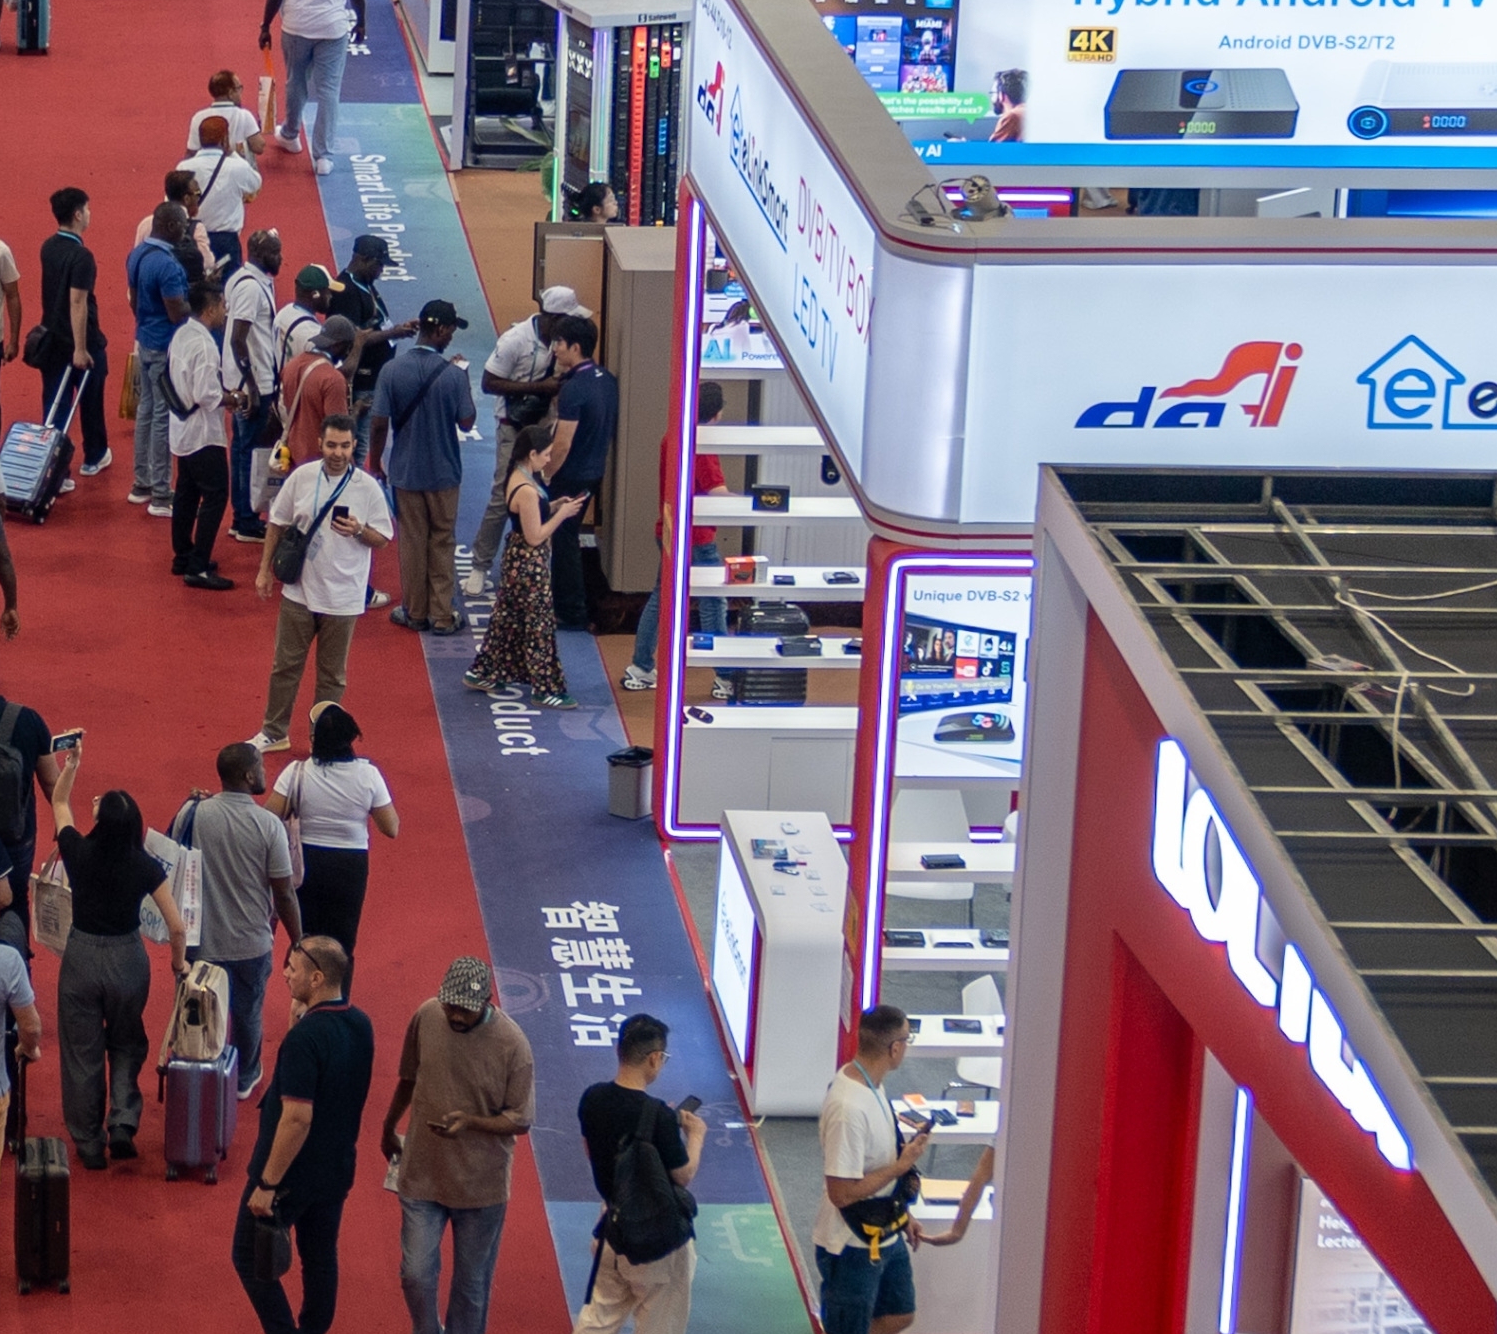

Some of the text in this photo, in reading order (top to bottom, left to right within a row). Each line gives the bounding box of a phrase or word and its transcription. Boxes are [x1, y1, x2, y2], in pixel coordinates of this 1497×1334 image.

[914, 17, 943, 29] MIAMI
[1072, 30, 1113, 52] 4K
[1218, 35, 1395, 51] Android DVB-S2/T2
[903, 97, 974, 108] the possibility of
[916, 106, 944, 115] results
[945, 106, 957, 115] of
[926, 144, 943, 158] AI
[349, 153, 401, 225] Smart Life
[742, 128, 790, 244] eLinkSmart
[797, 175, 877, 355] DVB/TV BOX
[792, 262, 839, 383] LED TV
[703, 338, 732, 362] AI
[913, 590, 1020, 603] Unique DVB-S2
